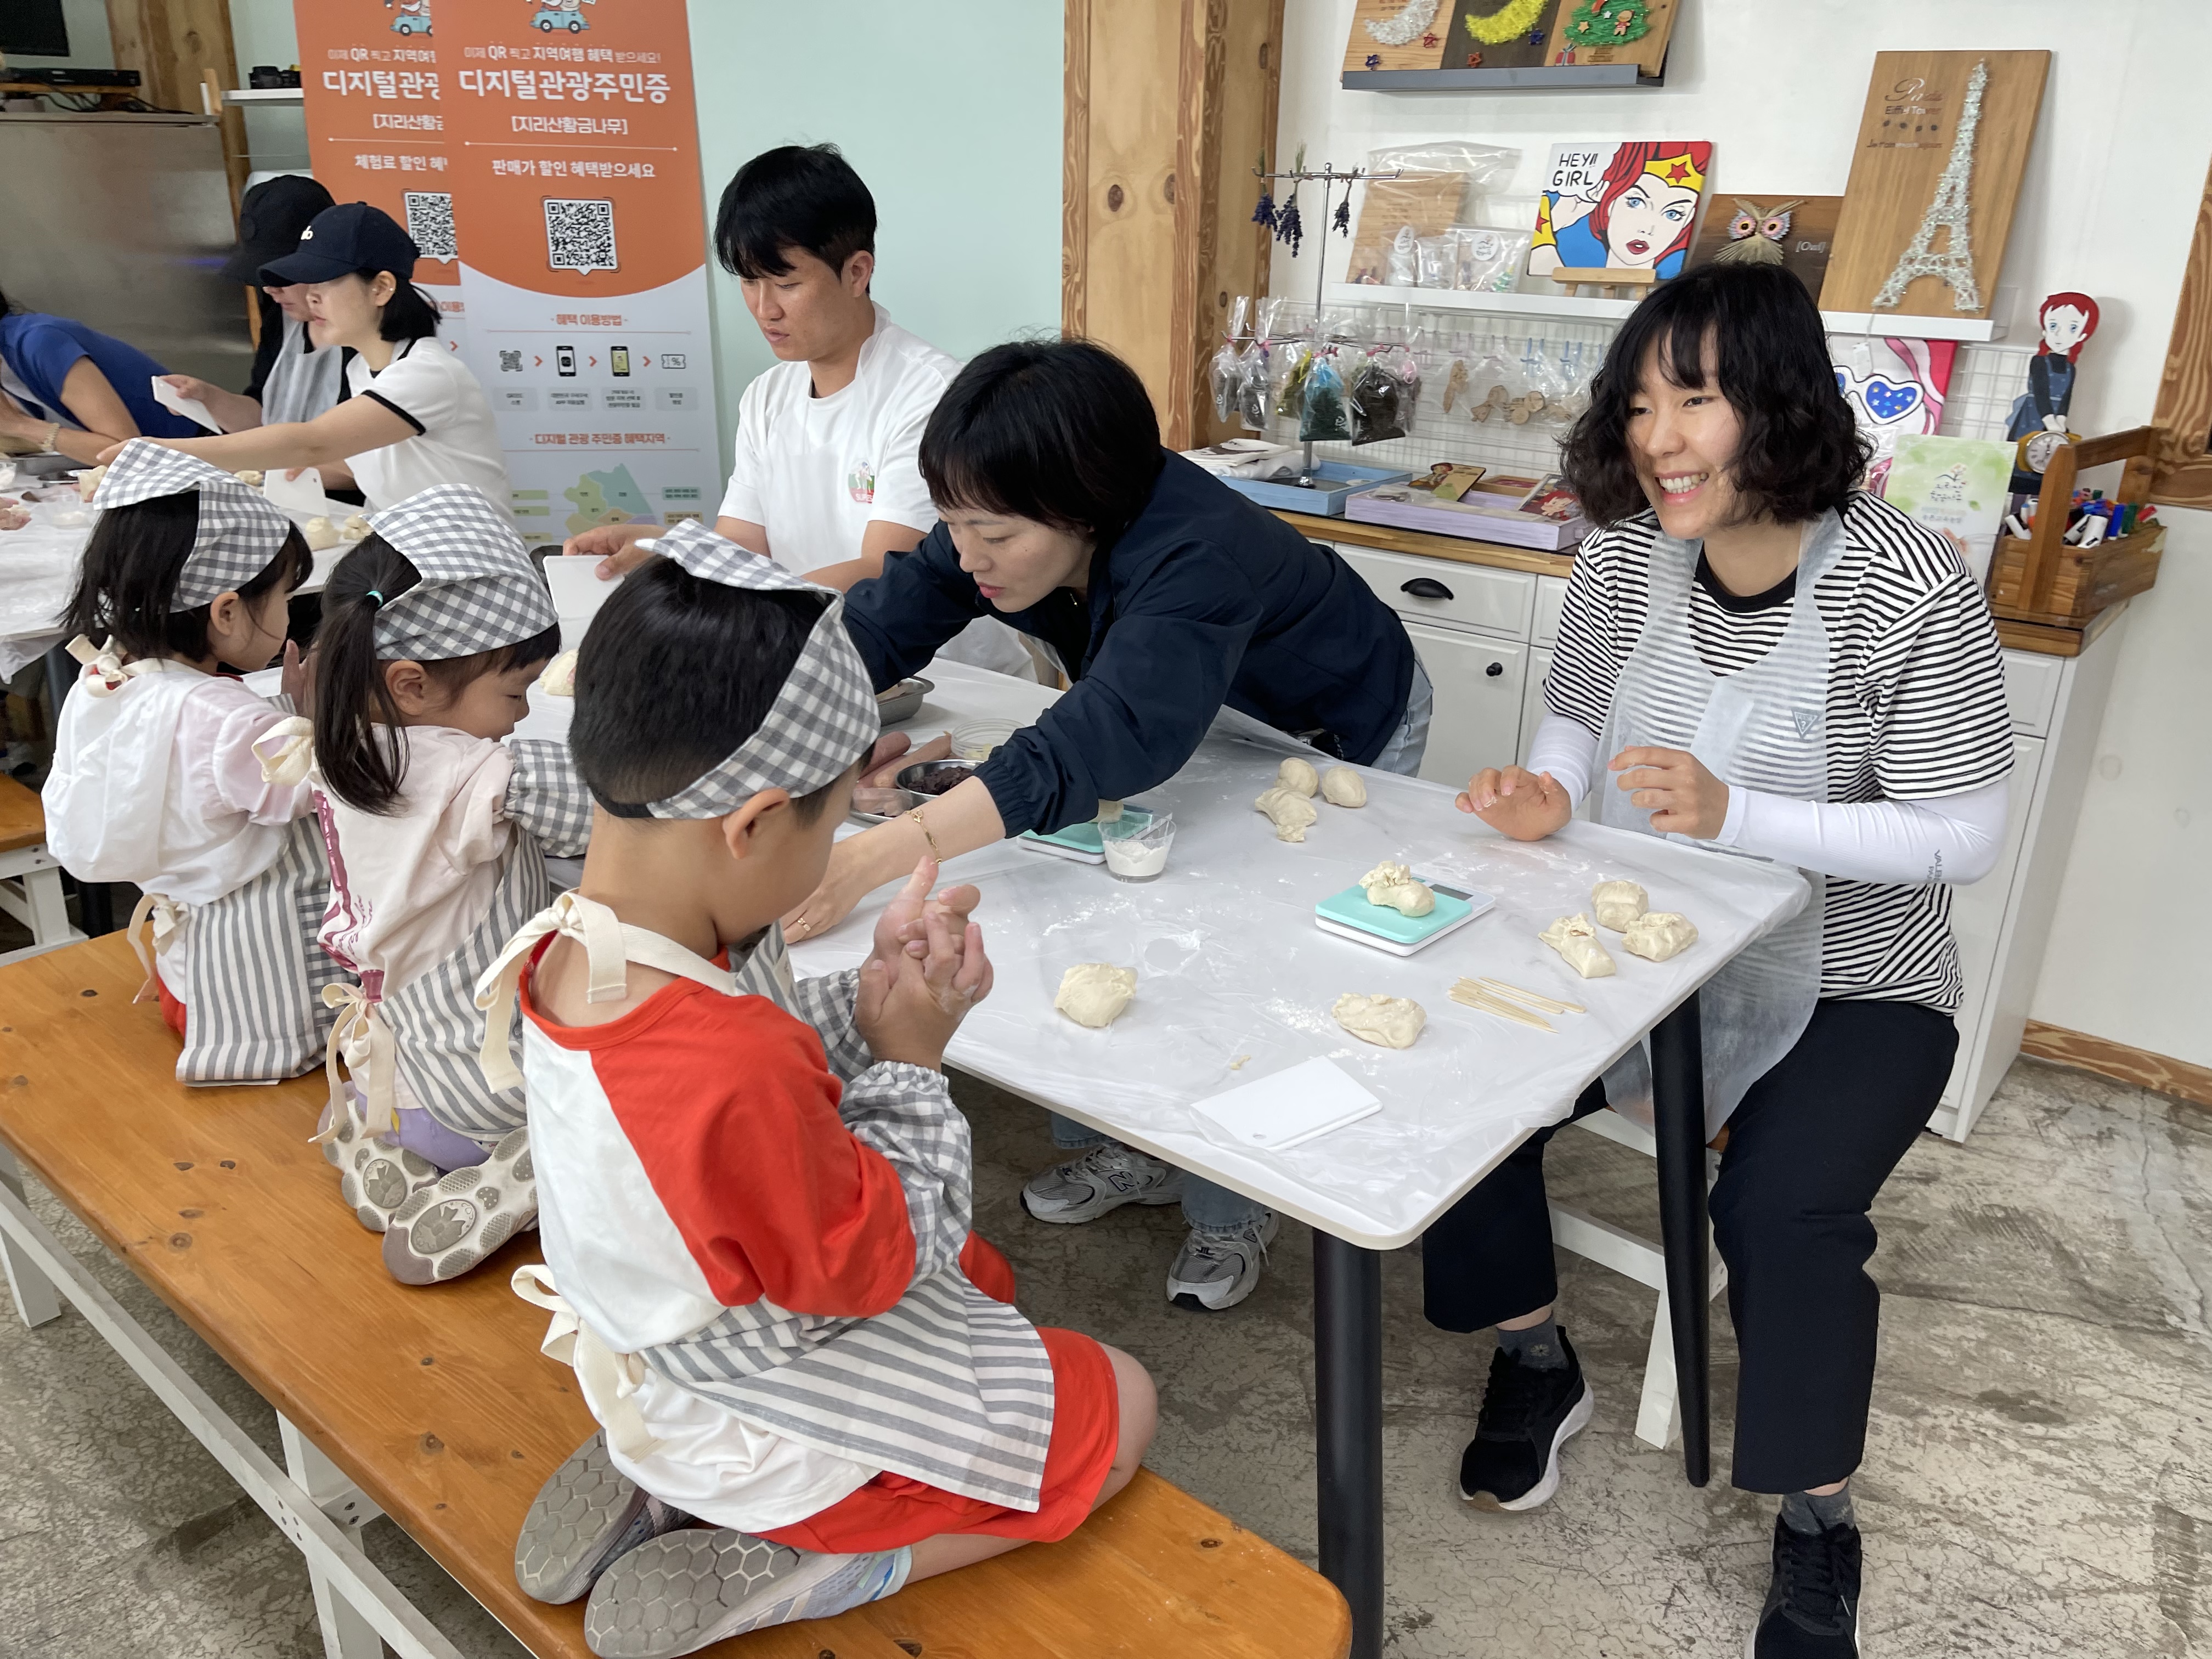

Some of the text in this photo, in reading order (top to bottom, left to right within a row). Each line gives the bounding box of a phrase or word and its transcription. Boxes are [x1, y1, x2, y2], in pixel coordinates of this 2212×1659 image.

[350, 48, 369, 62] QR
[488, 46, 507, 61] QR
[533, 47, 585, 62] 지역여행
[588, 49, 614, 64] 혜택
[458, 69, 671, 104] 디지털관광주민증
[511, 116, 628, 135] [지리산황금나무]
[354, 154, 448, 172] 체험료 할인 혜
[492, 159, 656, 179] 판매가 할인 혜택받으세요
[1553, 170, 1594, 187] GIRL
[580, 314, 622, 326] 이용방법
[534, 433, 566, 444] 디지털
[568, 433, 589, 444] 관광
[591, 433, 623, 444] 주민증
